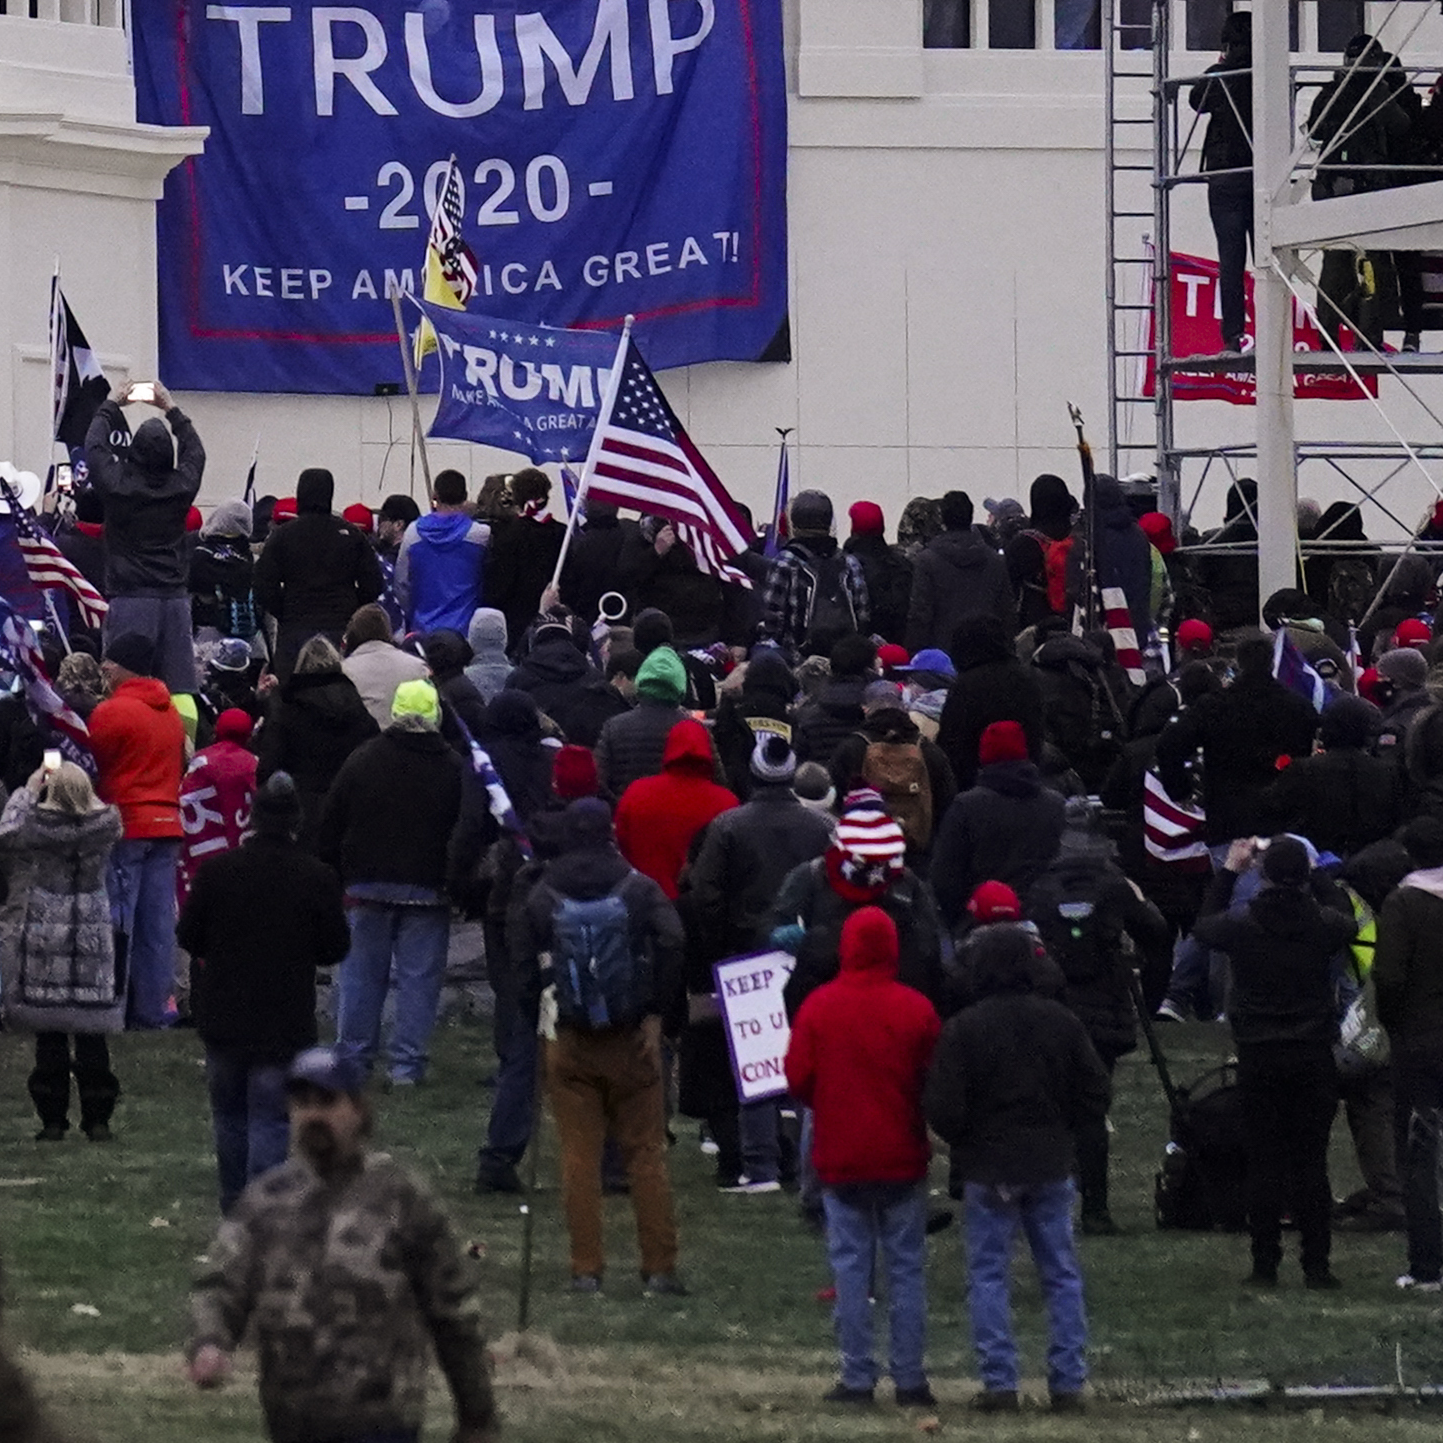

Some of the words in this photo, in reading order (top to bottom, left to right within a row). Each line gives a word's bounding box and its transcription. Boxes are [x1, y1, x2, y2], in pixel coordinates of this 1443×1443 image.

[223, 264, 333, 298] KEEP
[351, 261, 562, 300] AMICA
[583, 231, 740, 288] GREAT!
[537, 413, 584, 432] GREAT
[724, 969, 775, 998] KEEP
[735, 1019, 762, 1040] TO
